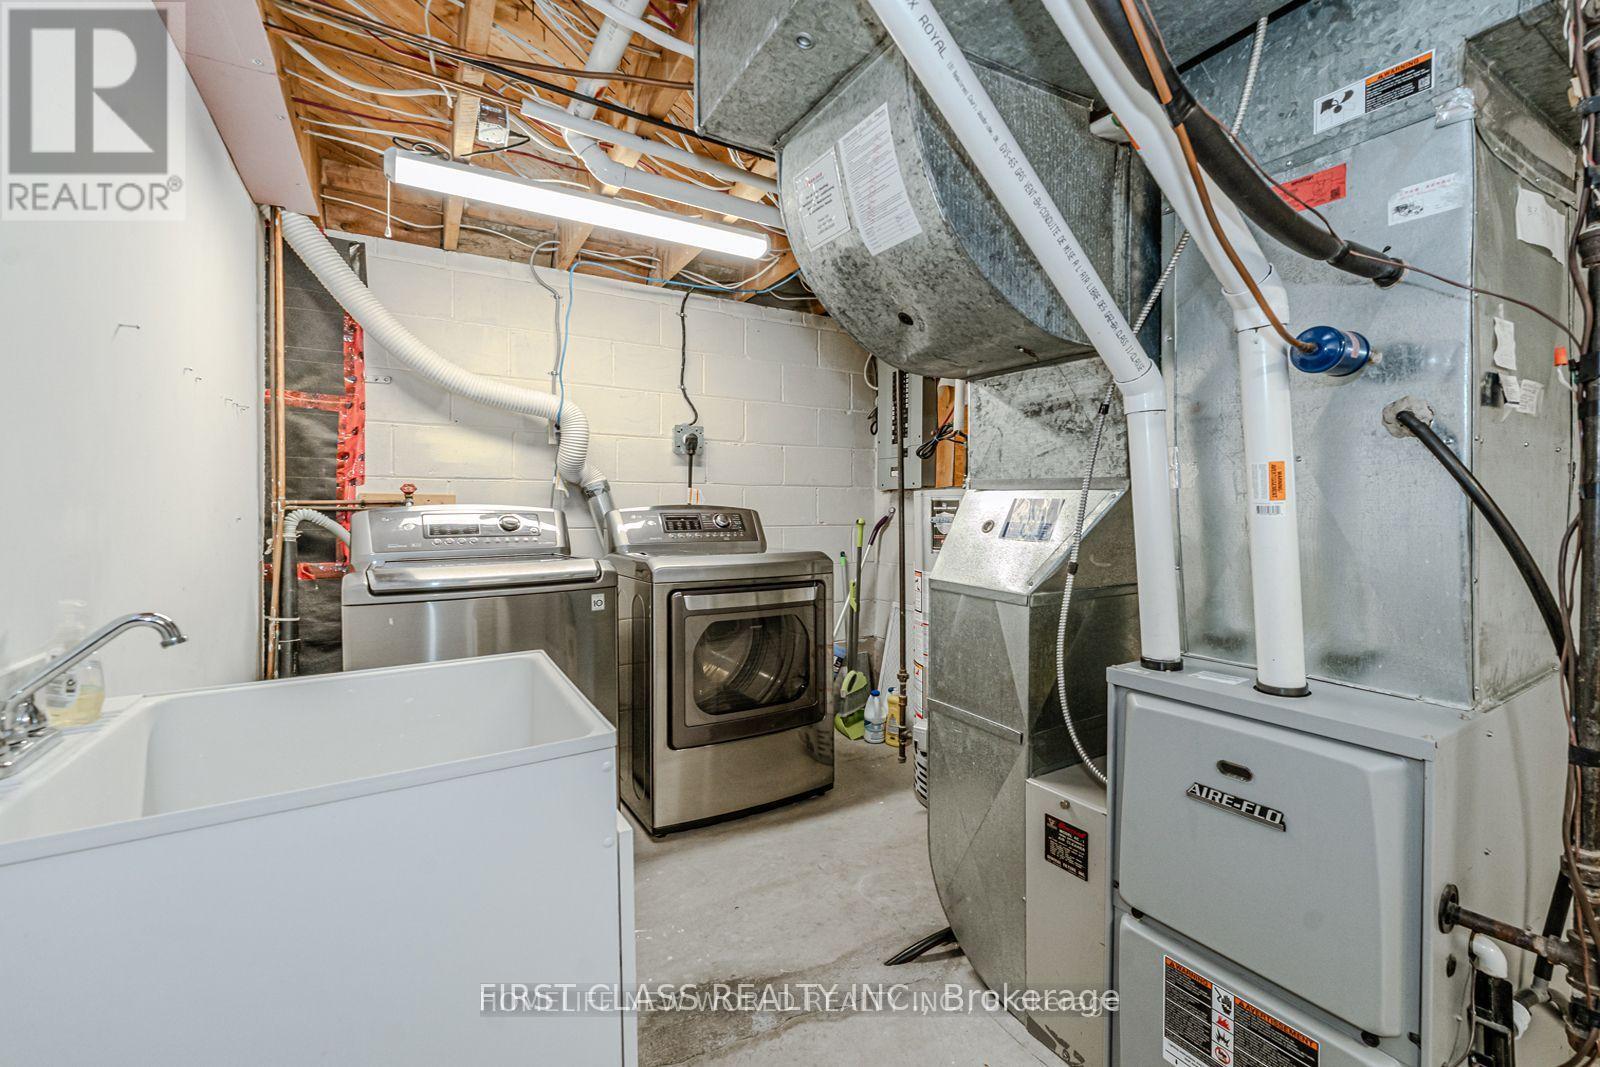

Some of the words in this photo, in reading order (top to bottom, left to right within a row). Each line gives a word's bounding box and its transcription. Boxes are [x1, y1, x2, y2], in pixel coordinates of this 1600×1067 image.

[917, 14, 950, 58] ROYAL
[1013, 166, 1028, 182] GAS
[1056, 234, 1068, 246] DE
[1061, 243, 1077, 260] MISE
[1085, 281, 1101, 301] LIBRE
[1095, 298, 1108, 312] DES
[1114, 328, 1130, 346] CLASS
[1187, 783, 1283, 825] AIRE-FLO
